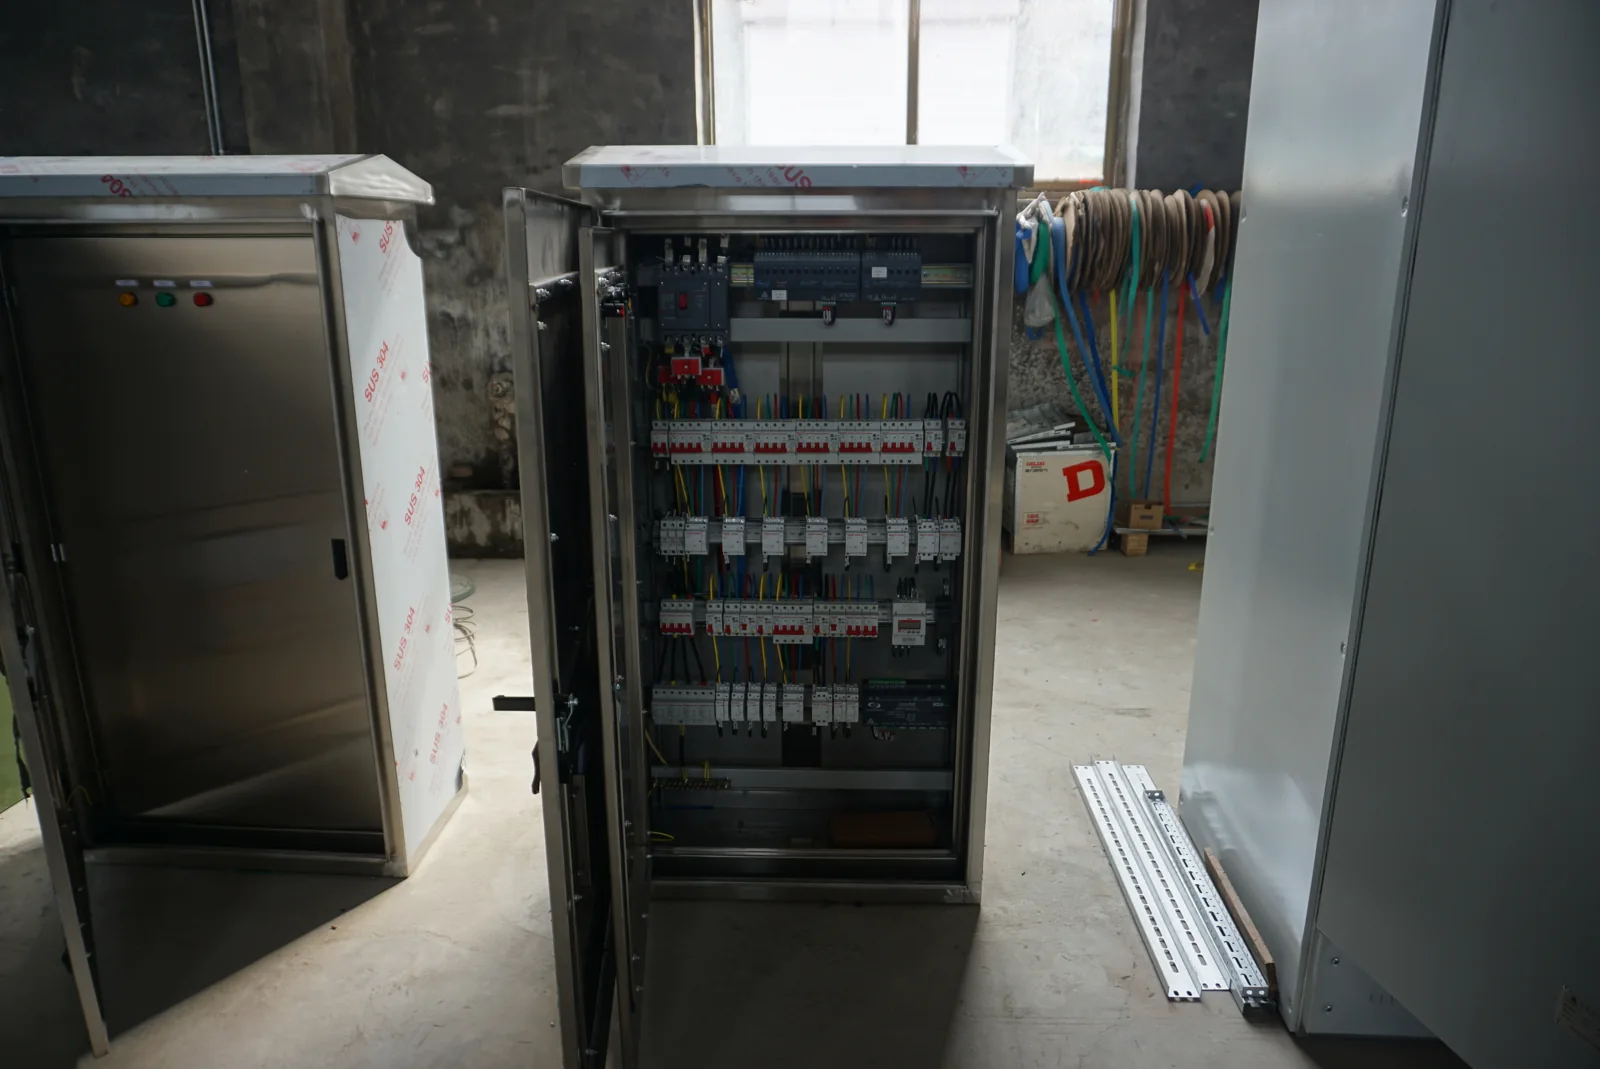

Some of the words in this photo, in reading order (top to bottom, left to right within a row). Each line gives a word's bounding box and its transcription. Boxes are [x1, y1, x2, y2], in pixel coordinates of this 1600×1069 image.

[379, 220, 393, 253] SUS
[365, 368, 379, 402] SUS
[377, 340, 389, 369] 304
[404, 492, 417, 525] SUS
[415, 465, 425, 492] 304
[1062, 460, 1106, 502] D
[394, 636, 407, 671] SUS
[404, 606, 415, 634] 304
[430, 731, 441, 765] SUS
[438, 702, 448, 729] 304
